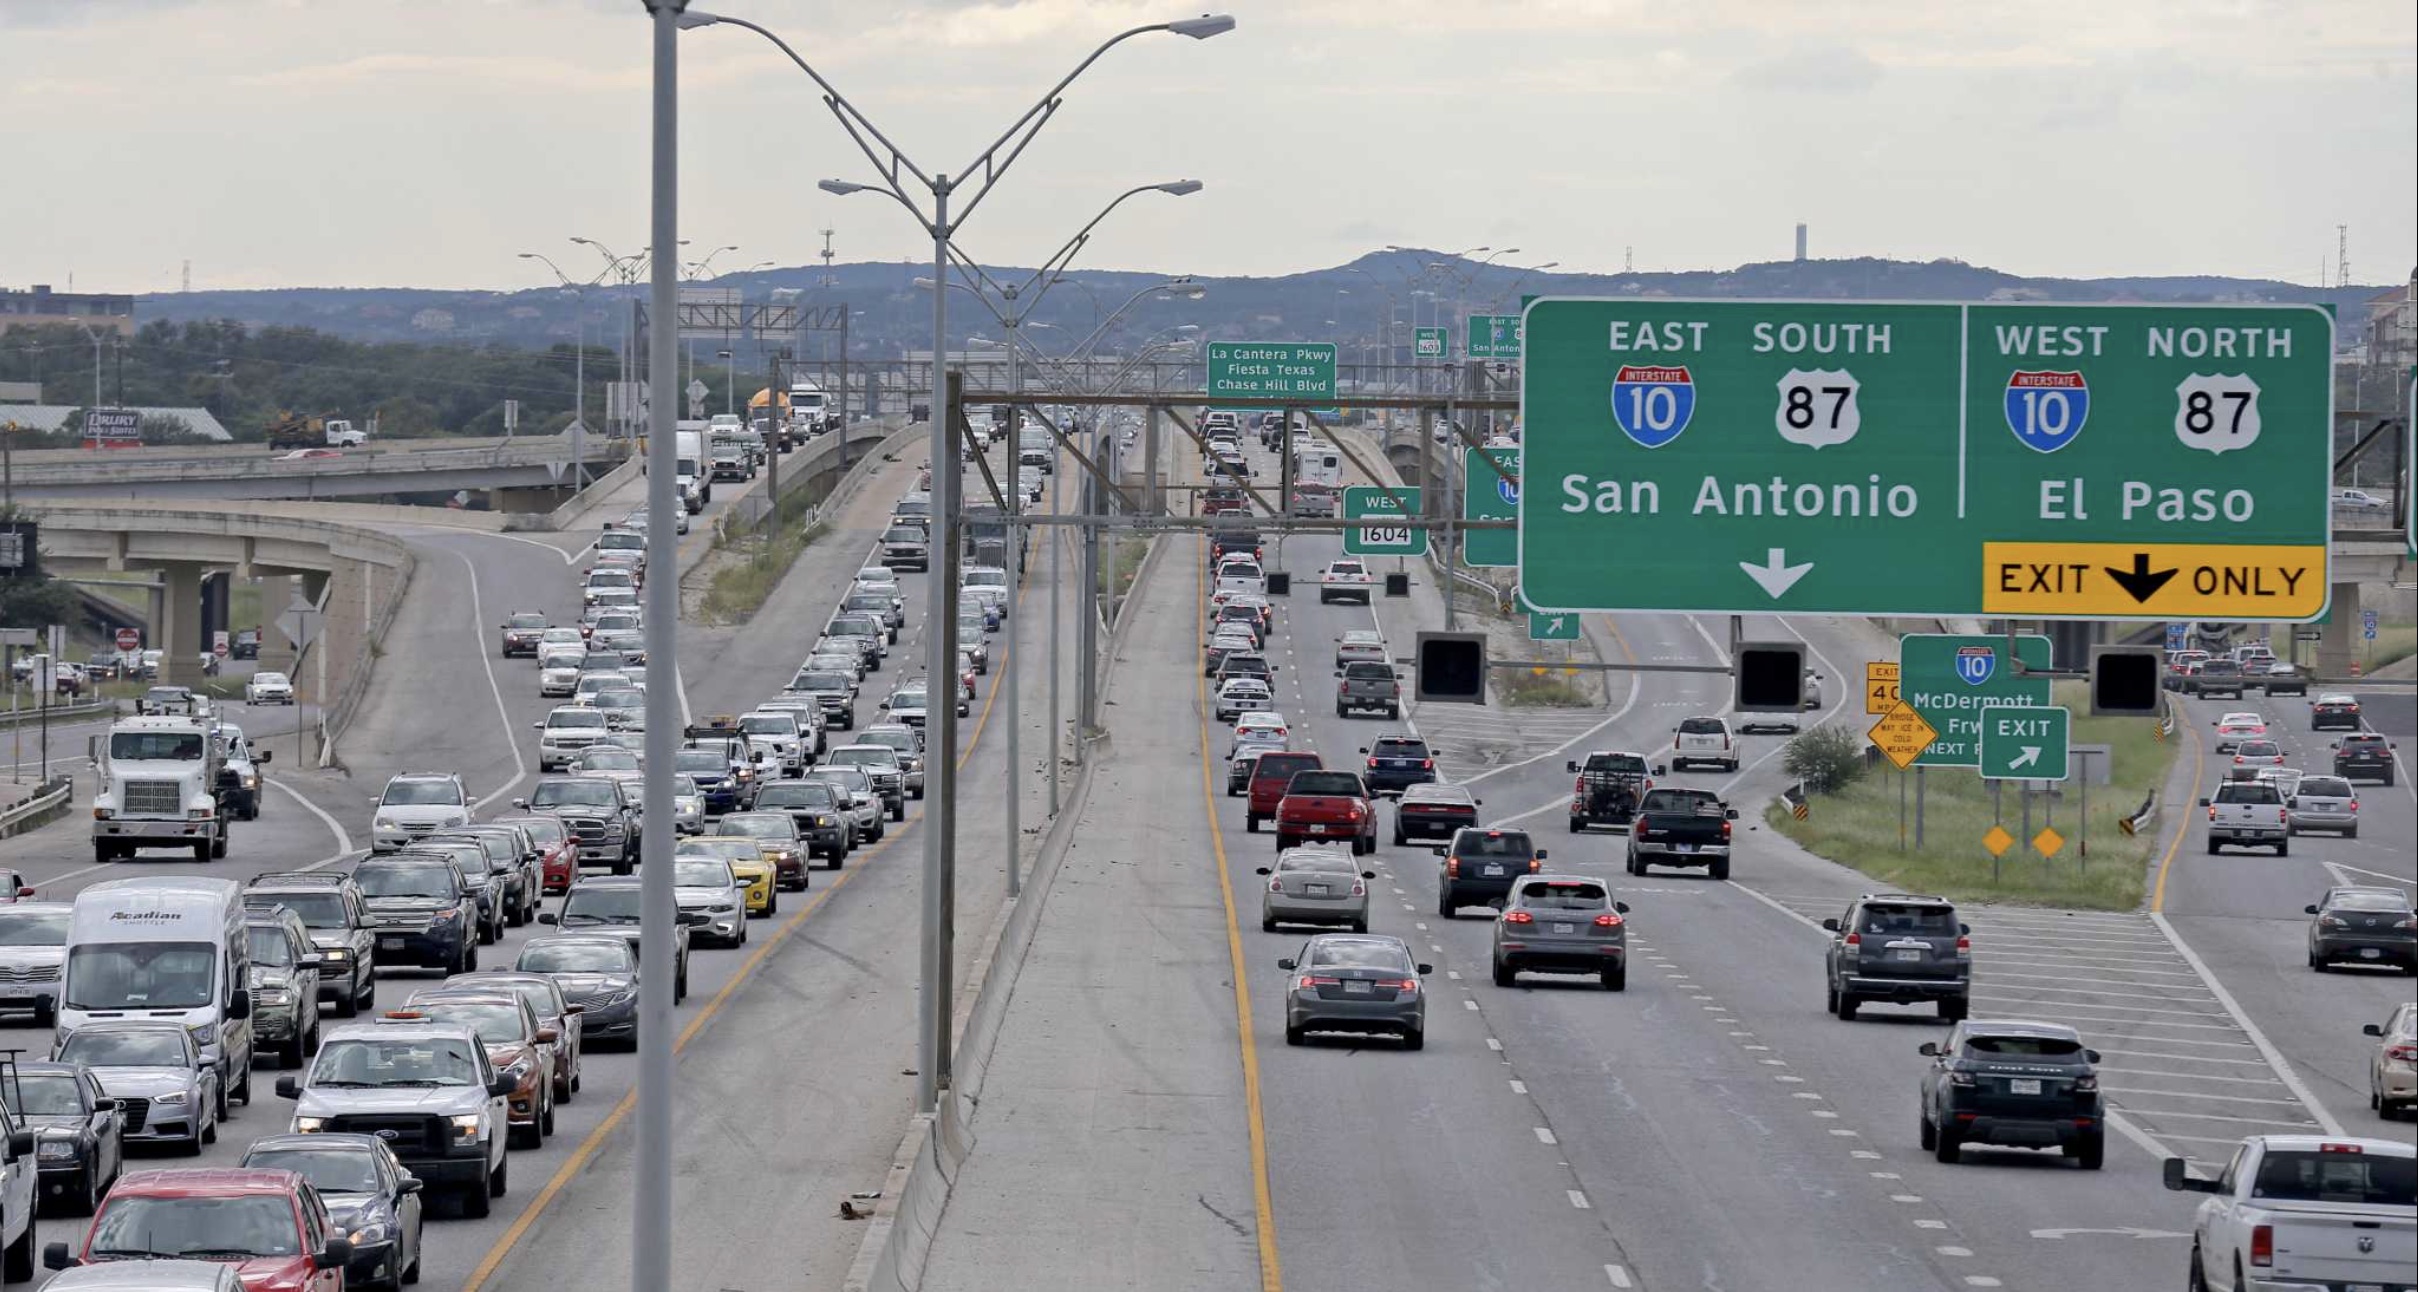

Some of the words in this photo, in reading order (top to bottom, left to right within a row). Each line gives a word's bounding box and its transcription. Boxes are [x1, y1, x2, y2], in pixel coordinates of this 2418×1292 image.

[1609, 320, 1709, 351] EAST
[1753, 322, 1891, 354] SOUTH
[1995, 325, 2109, 357] WEST
[2147, 327, 2292, 358] NORTH
[1212, 349, 1227, 359] La
[1234, 349, 1288, 360] Cantera
[1297, 349, 1331, 363] Pkwy
[1473, 344, 1490, 352] San
[1228, 363, 1269, 375] Fiesta
[1277, 364, 1315, 376] Texas
[1625, 370, 1683, 383] INTERSTATE
[1217, 379, 1258, 390] Chase
[1265, 379, 1289, 391] Hill
[1297, 379, 1327, 391] Blvd
[2018, 374, 2077, 388] INTERSTATE
[1630, 385, 1676, 431] 10
[1785, 385, 1851, 430] 87
[2022, 390, 2070, 436] 10
[2185, 390, 2252, 434] 87
[1365, 496, 1407, 508] WEST
[1562, 473, 1660, 514] San
[1692, 473, 1918, 517] Antonio
[2039, 477, 2088, 520] El
[2122, 480, 2255, 522] Paso
[1364, 526, 1409, 542] 1604
[2001, 563, 2090, 593] EXIT
[2193, 566, 2306, 596] ONLY
[1963, 656, 1987, 678] 10
[1914, 692, 2033, 709] McDermott
[1998, 720, 2051, 736] EXIT
[1925, 743, 1965, 755] NEXT
